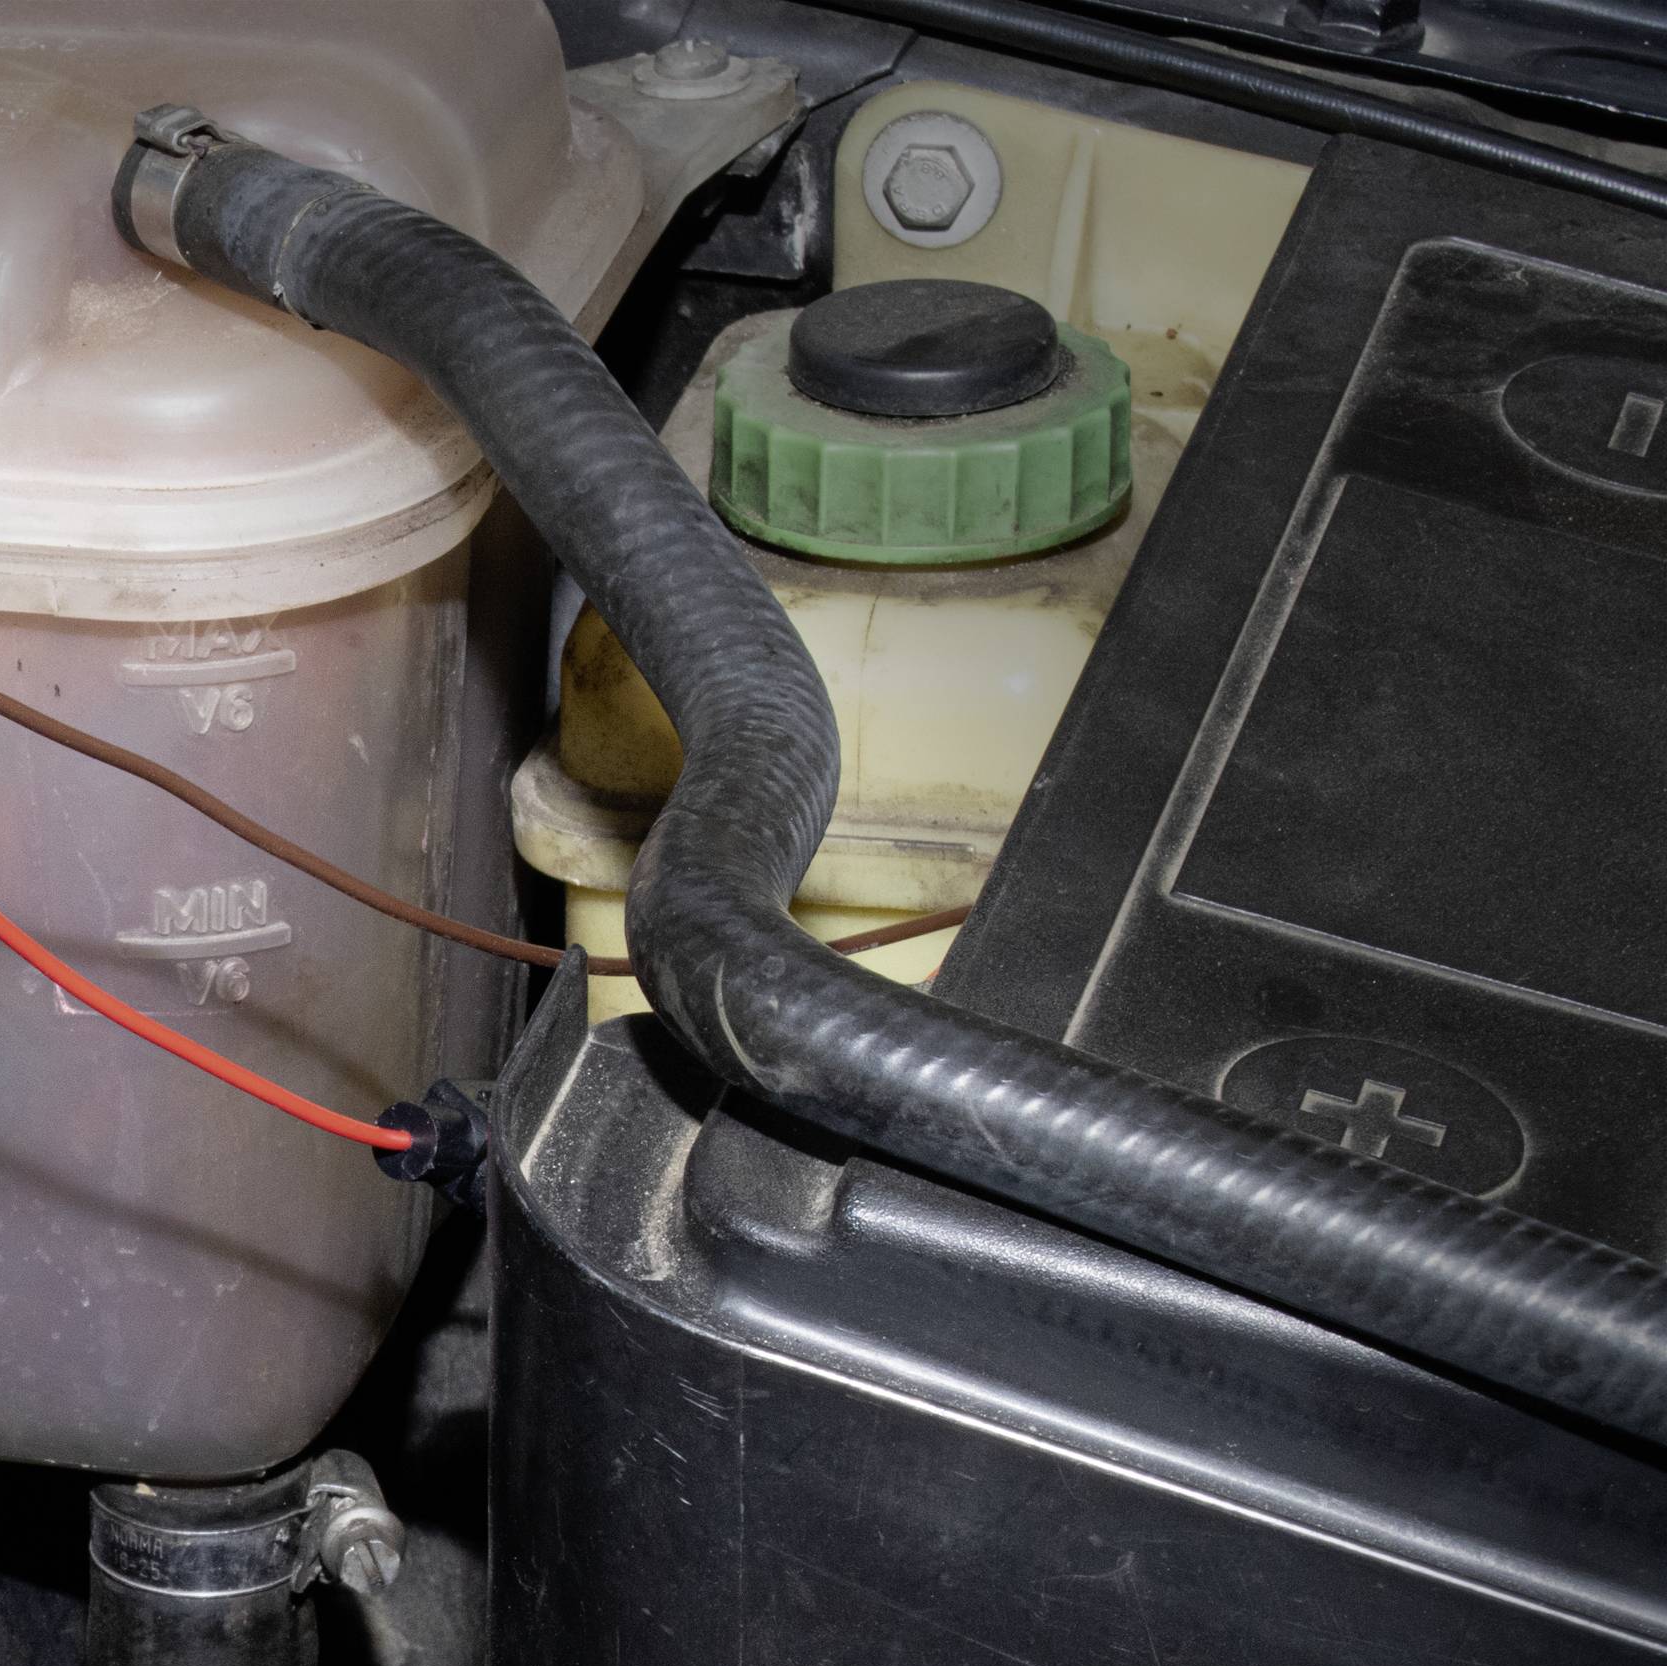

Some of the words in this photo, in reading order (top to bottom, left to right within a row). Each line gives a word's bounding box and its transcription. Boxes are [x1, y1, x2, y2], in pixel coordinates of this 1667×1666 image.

[179, 685, 254, 734] V6
[154, 879, 267, 935] MIN
[176, 956, 250, 1005] V6
